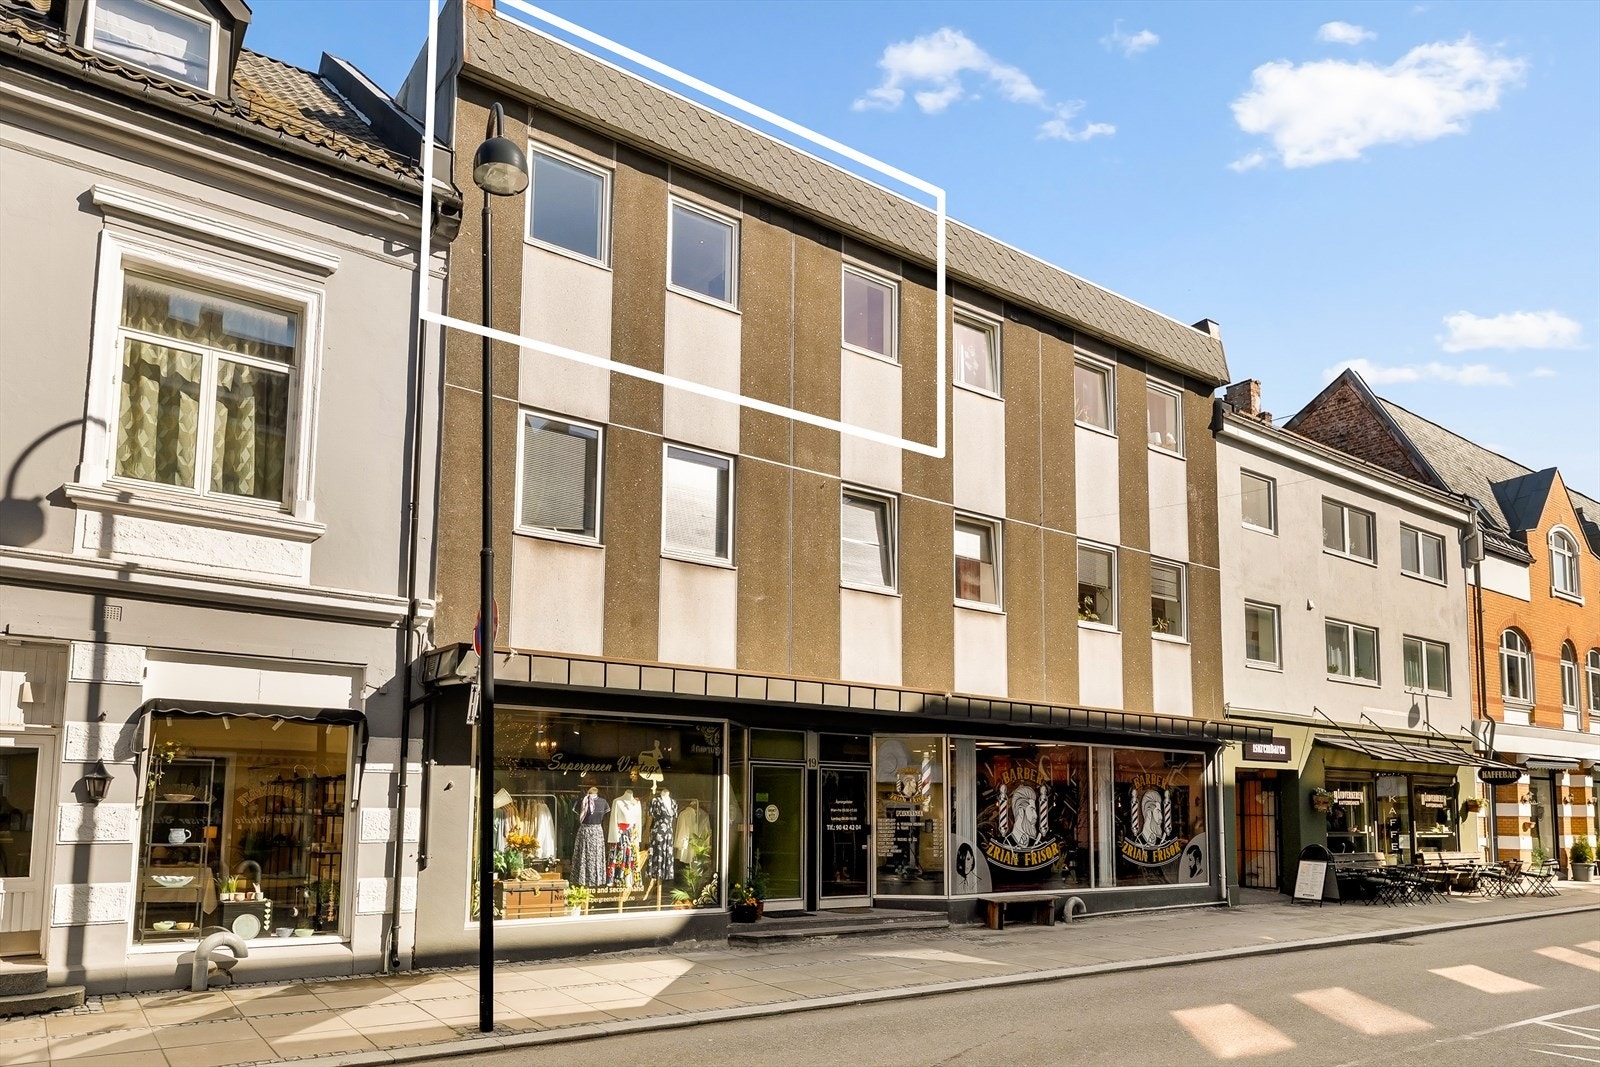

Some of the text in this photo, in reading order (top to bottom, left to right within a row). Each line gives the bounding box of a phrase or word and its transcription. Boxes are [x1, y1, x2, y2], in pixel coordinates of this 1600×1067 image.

[548, 753, 661, 778] Supergreen Vintage
[808, 758, 817, 768] 19
[1002, 767, 1046, 785] BARBER
[1133, 773, 1169, 789] BARBER
[1482, 770, 1518, 779] KAFFEBAR
[1388, 795, 1399, 851] KAFFE
[986, 842, 1019, 866] ZRIAN
[1121, 840, 1181, 863] ZRIAN FRISØR
